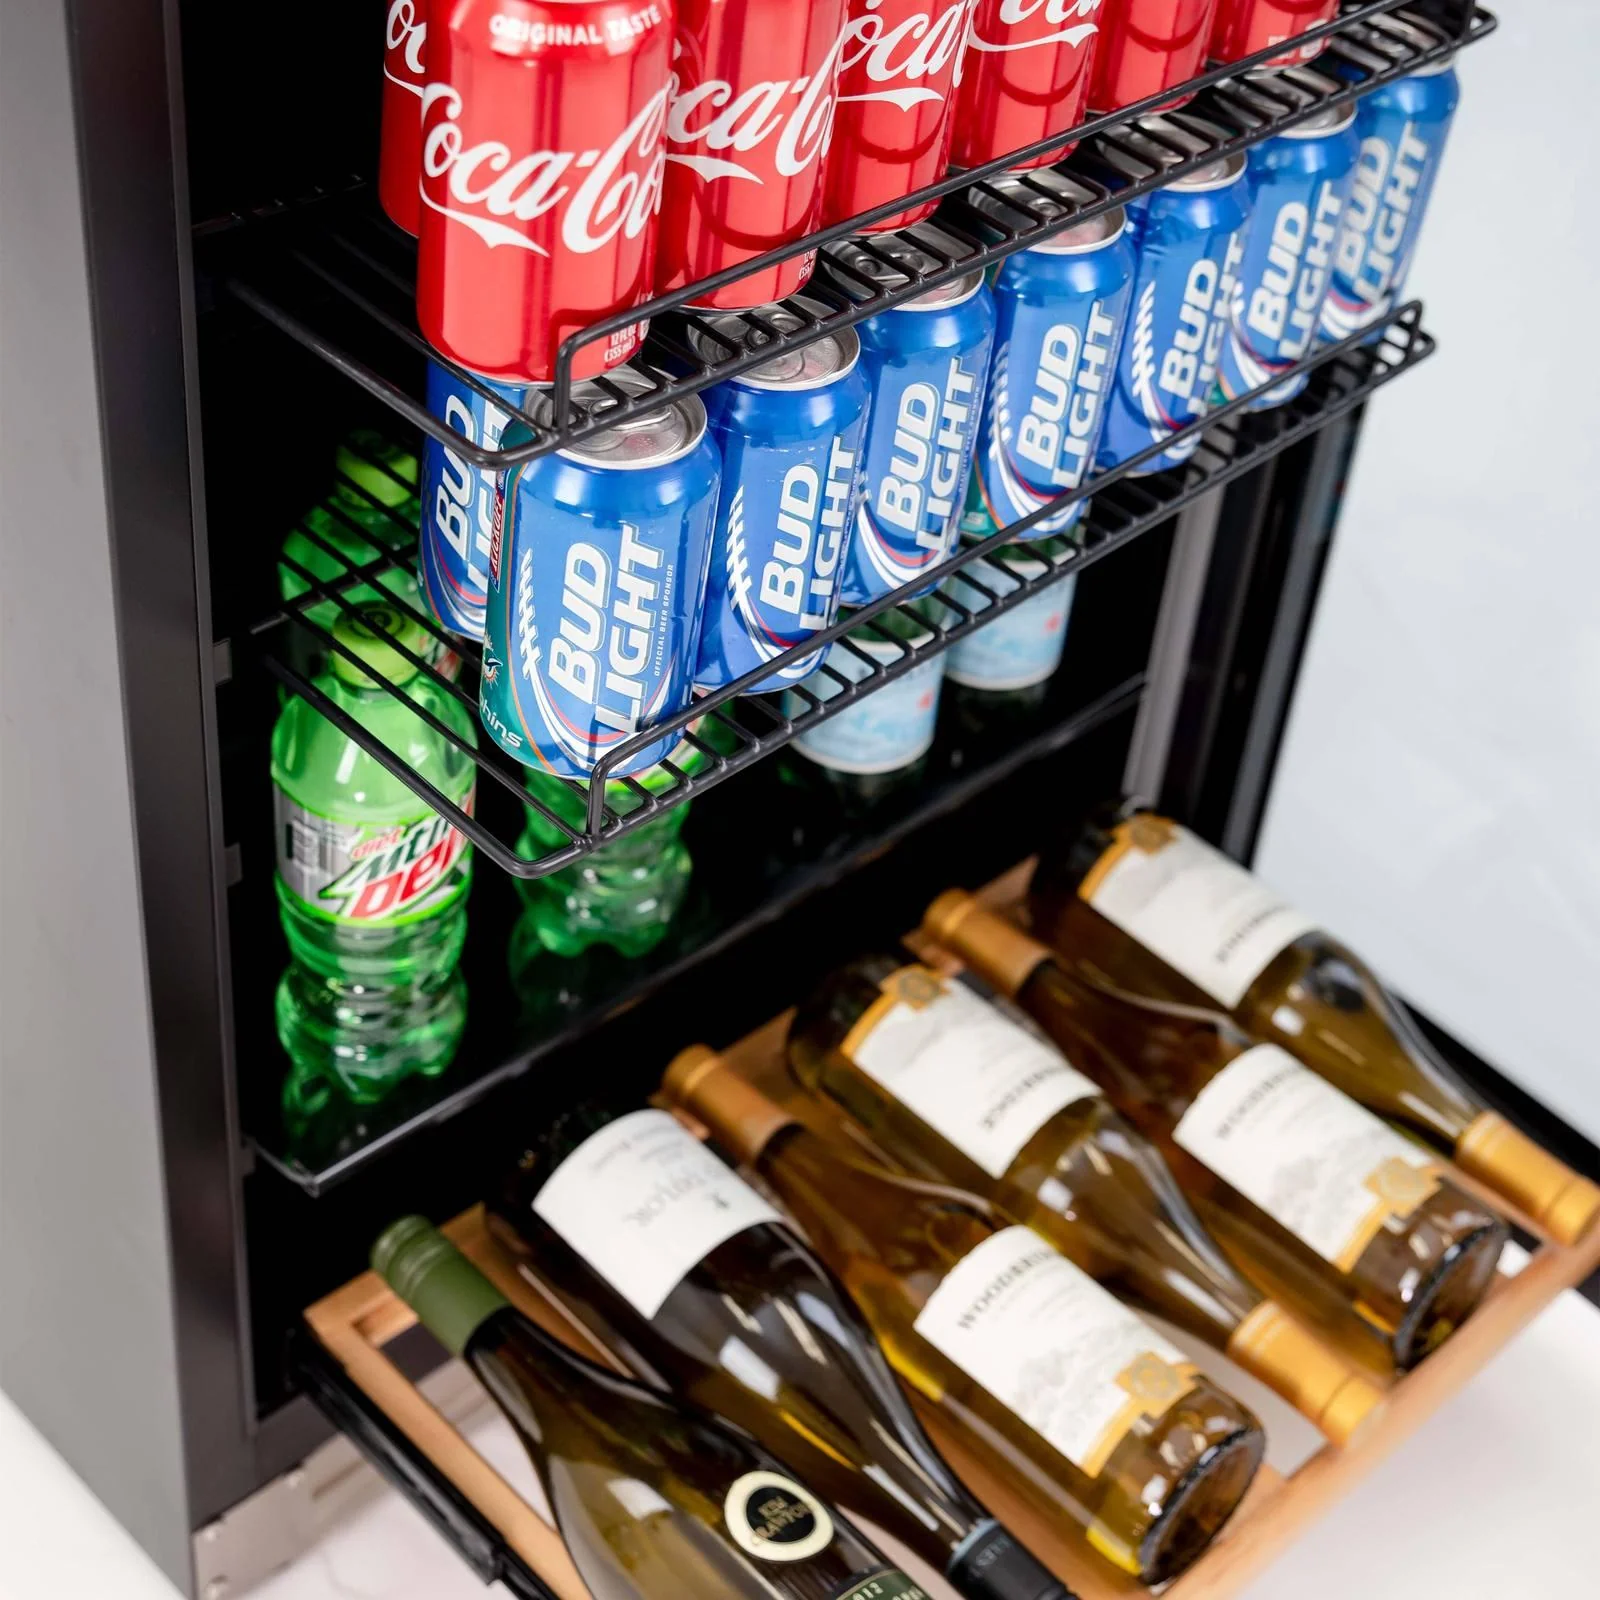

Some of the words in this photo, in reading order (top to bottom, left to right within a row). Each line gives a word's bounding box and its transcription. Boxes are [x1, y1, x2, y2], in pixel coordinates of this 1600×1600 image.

[490, 14, 603, 46] ORIGINAL
[607, 4, 662, 41] TASTE
[1247, 201, 1309, 341] BUD
[1277, 179, 1343, 361] LIGHT
[1353, 120, 1428, 302] LIGHT
[1015, 323, 1081, 470] BUD
[1051, 299, 1115, 489] LIGHT
[1158, 258, 1219, 399] BUD
[876, 381, 941, 532] BUD
[916, 356, 977, 552] LIGHT
[662, 563, 674, 608] SPONSOR
[760, 463, 819, 615] BUD
[799, 435, 855, 631] LIGHT
[548, 541, 613, 706] BUD
[594, 523, 665, 736] LIGHT
[653, 636, 666, 678] OFFICIAL
[659, 607, 669, 634] BEER
